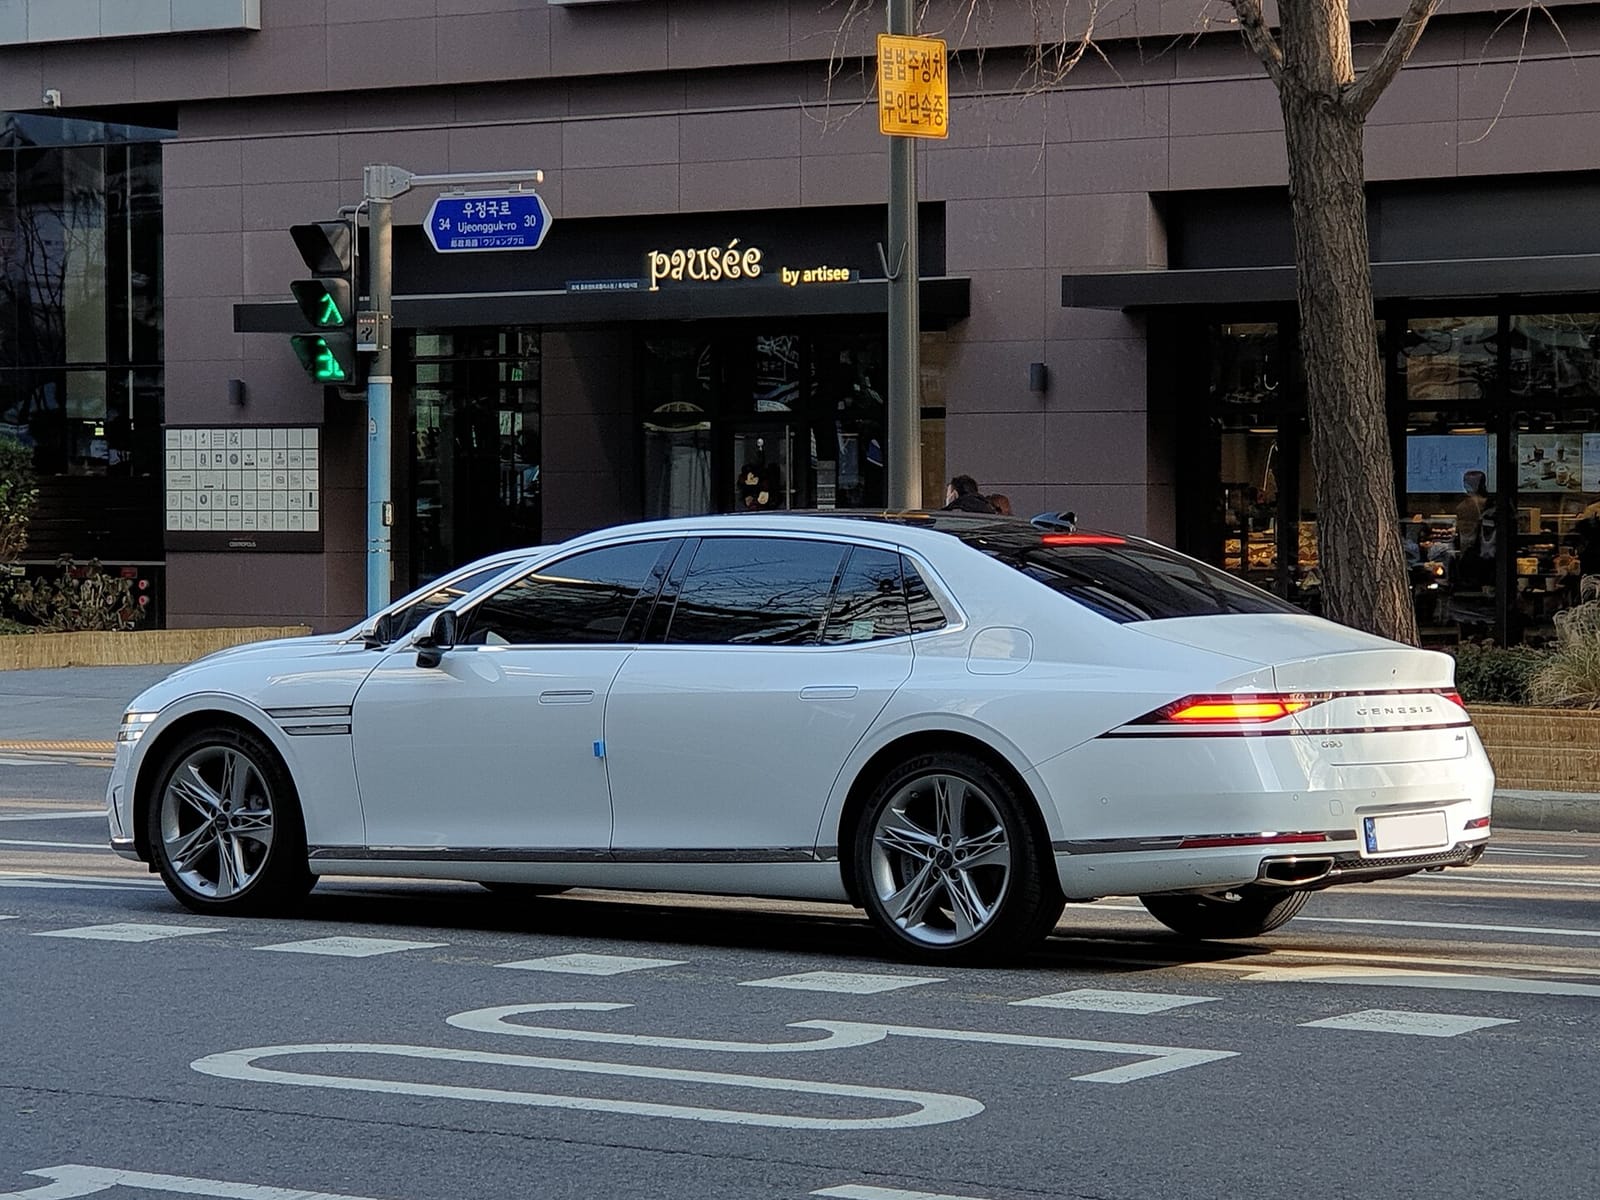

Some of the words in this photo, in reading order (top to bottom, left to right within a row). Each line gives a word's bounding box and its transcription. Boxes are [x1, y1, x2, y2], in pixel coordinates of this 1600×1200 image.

[884, 47, 943, 84] 불법주정차
[884, 90, 944, 126] 무인단속중
[462, 201, 511, 218] 우정국로
[438, 217, 451, 231] 34
[457, 220, 517, 234] Ujeongguk-ro
[523, 214, 536, 227] 30
[648, 237, 762, 291] pausée
[782, 266, 800, 286] by
[803, 265, 850, 282] artisee
[1356, 705, 1433, 716] GENESIS
